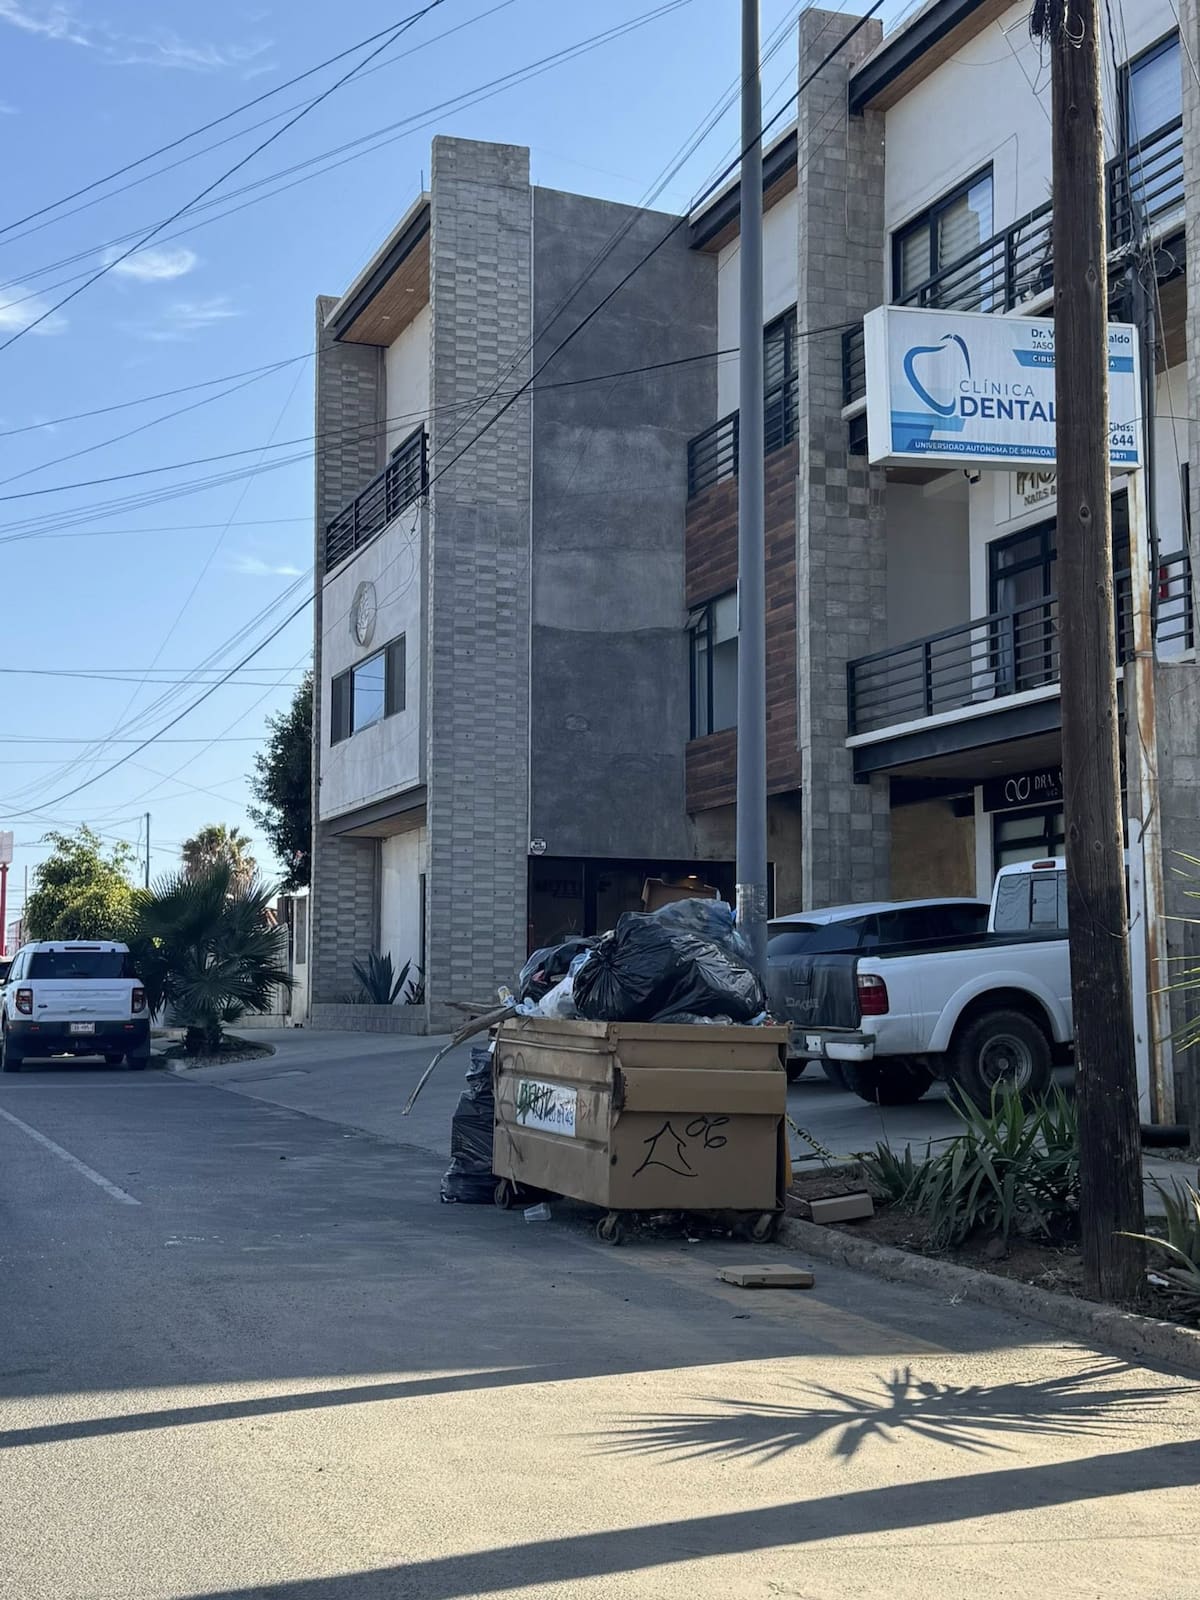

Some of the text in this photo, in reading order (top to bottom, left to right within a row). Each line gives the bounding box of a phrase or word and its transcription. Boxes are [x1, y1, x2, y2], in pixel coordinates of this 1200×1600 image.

[1031, 328, 1046, 338] Dr.
[1109, 334, 1130, 344] aldo
[959, 379, 1035, 397] CLÍNICA
[960, 396, 1056, 422] DENTAL
[1110, 433, 1134, 446] 644
[914, 441, 965, 451] UNIVERSIDAD
[1009, 446, 1019, 455] DE
[1020, 447, 1051, 456] SINALOA
